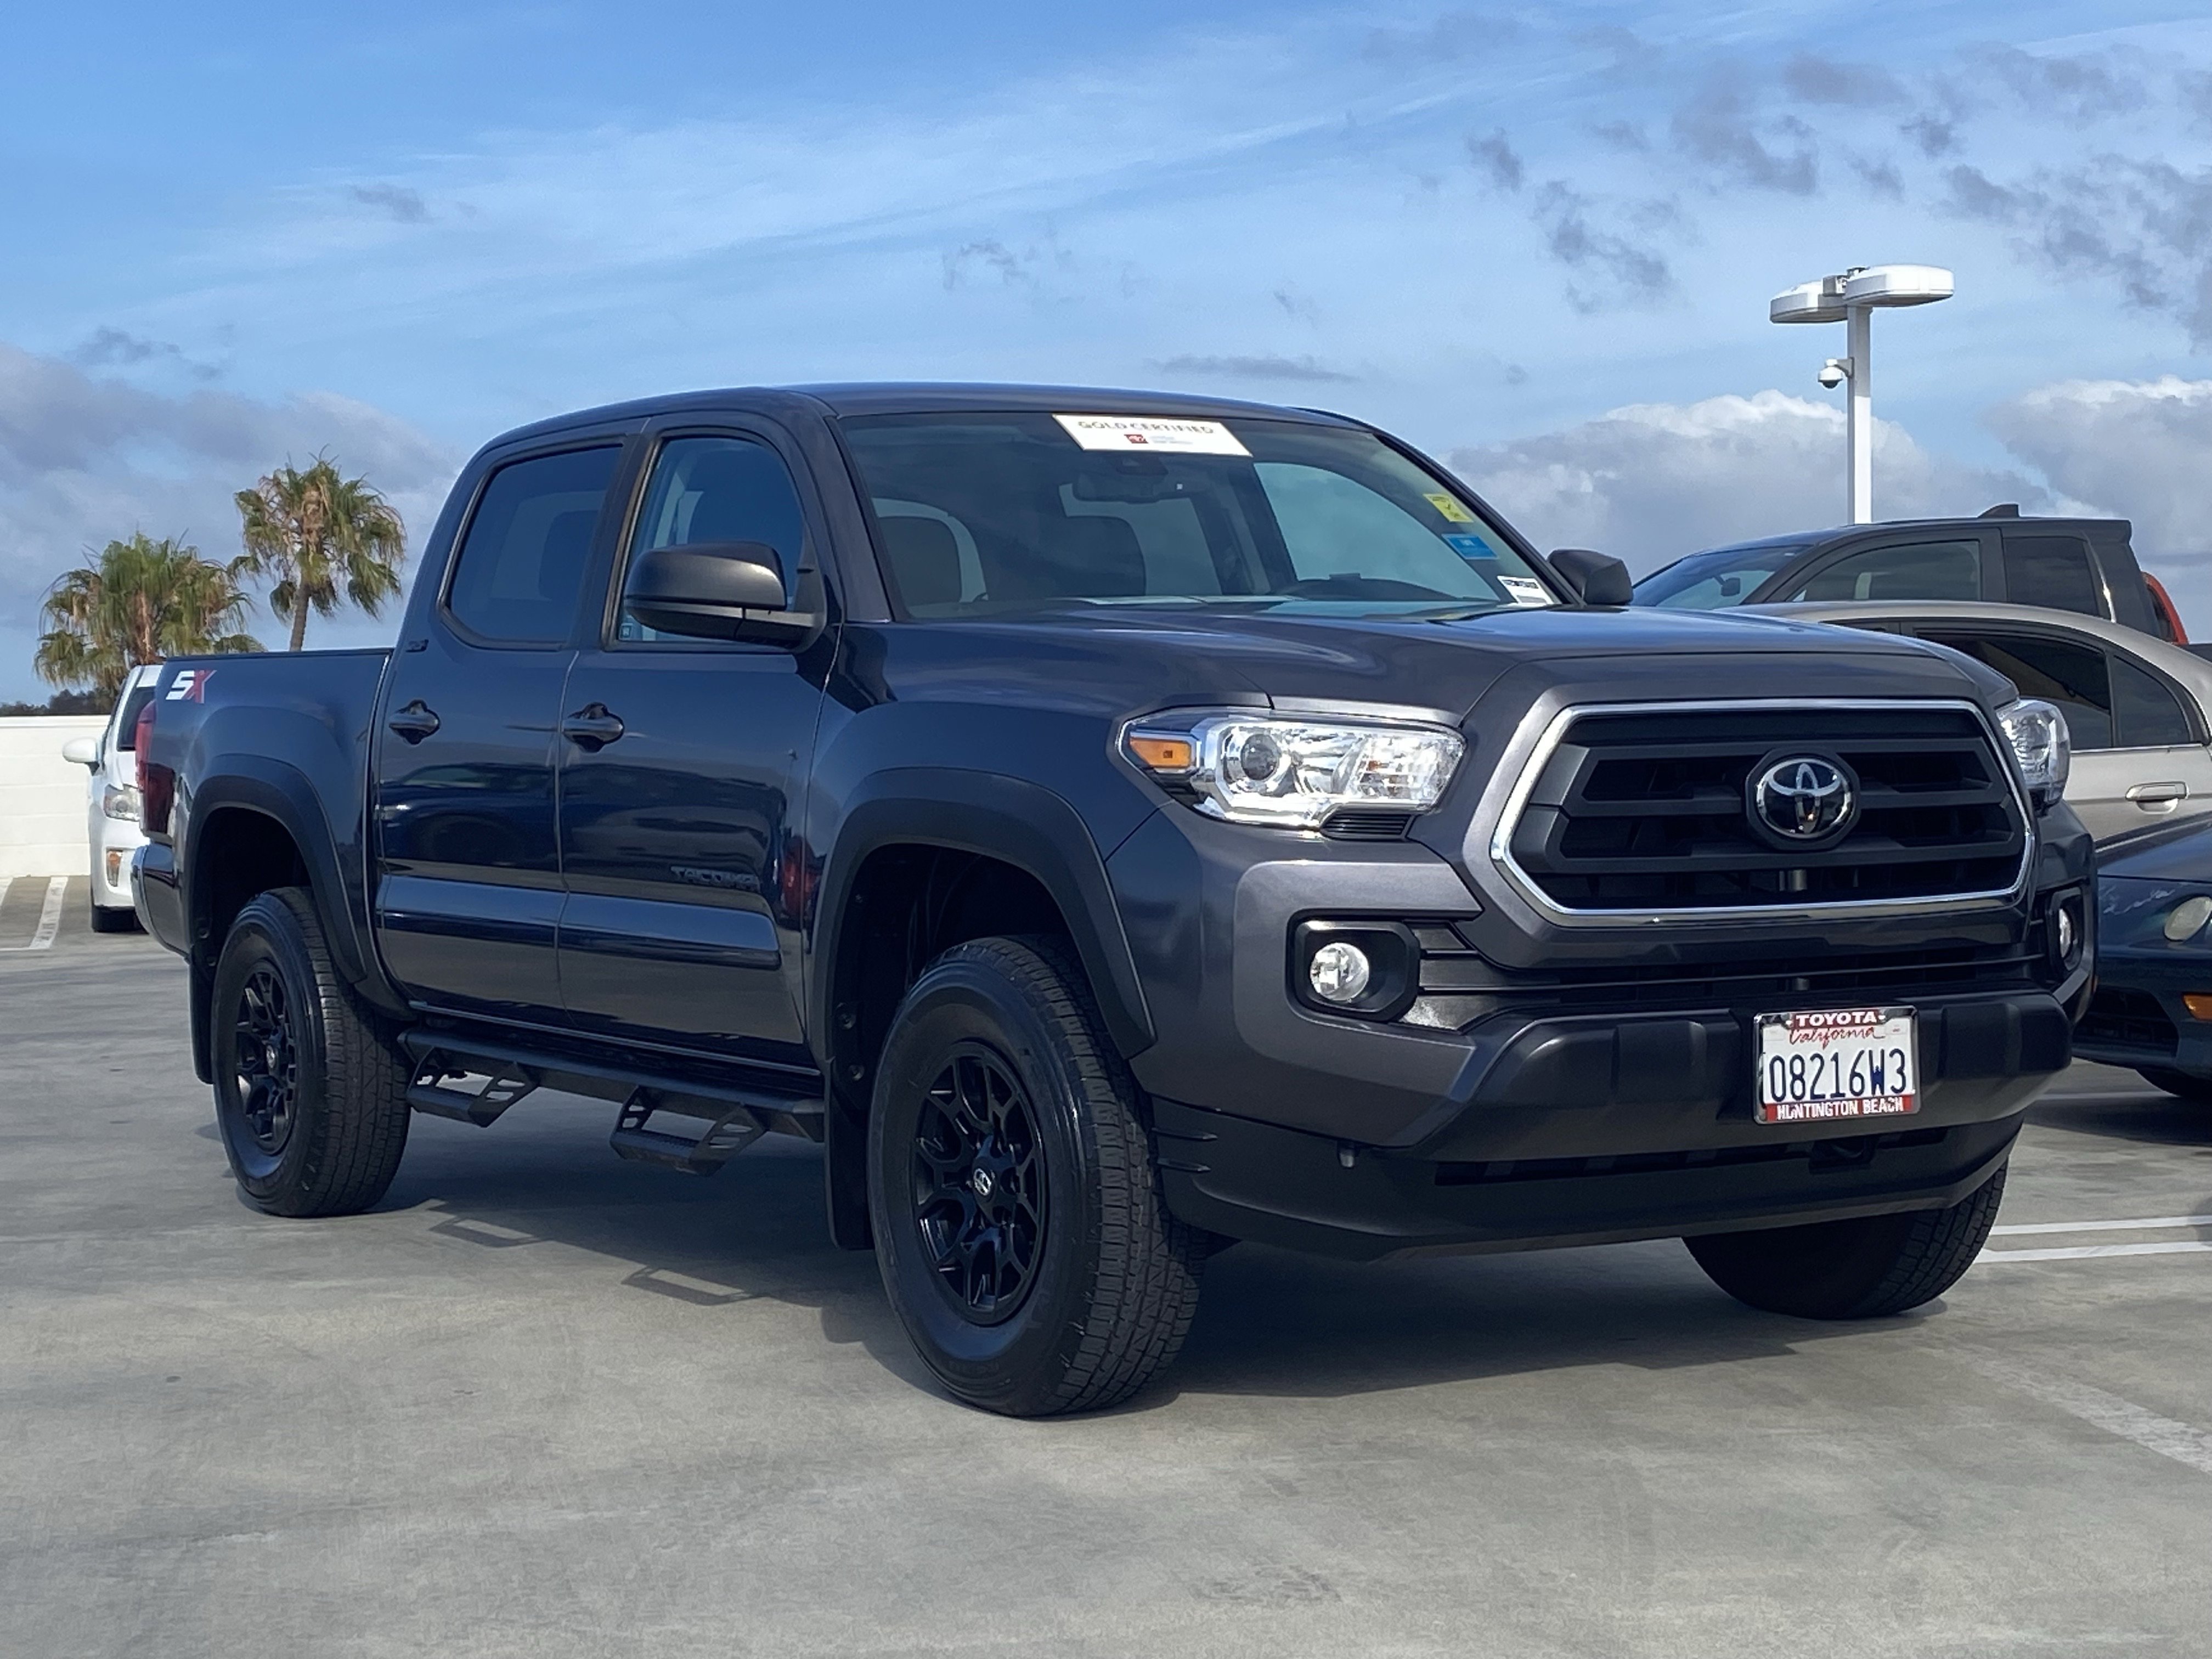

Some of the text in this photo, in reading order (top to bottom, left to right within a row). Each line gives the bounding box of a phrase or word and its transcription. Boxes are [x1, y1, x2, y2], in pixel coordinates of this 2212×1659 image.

[1077, 420, 1214, 435] GOLD CERTIFIED
[1796, 1011, 1877, 1026] TOYOTA
[1790, 1026, 1885, 1049] California
[1769, 1048, 1906, 1102] 08216W3
[1777, 1097, 1904, 1120] HUNTINGTON BEACH
